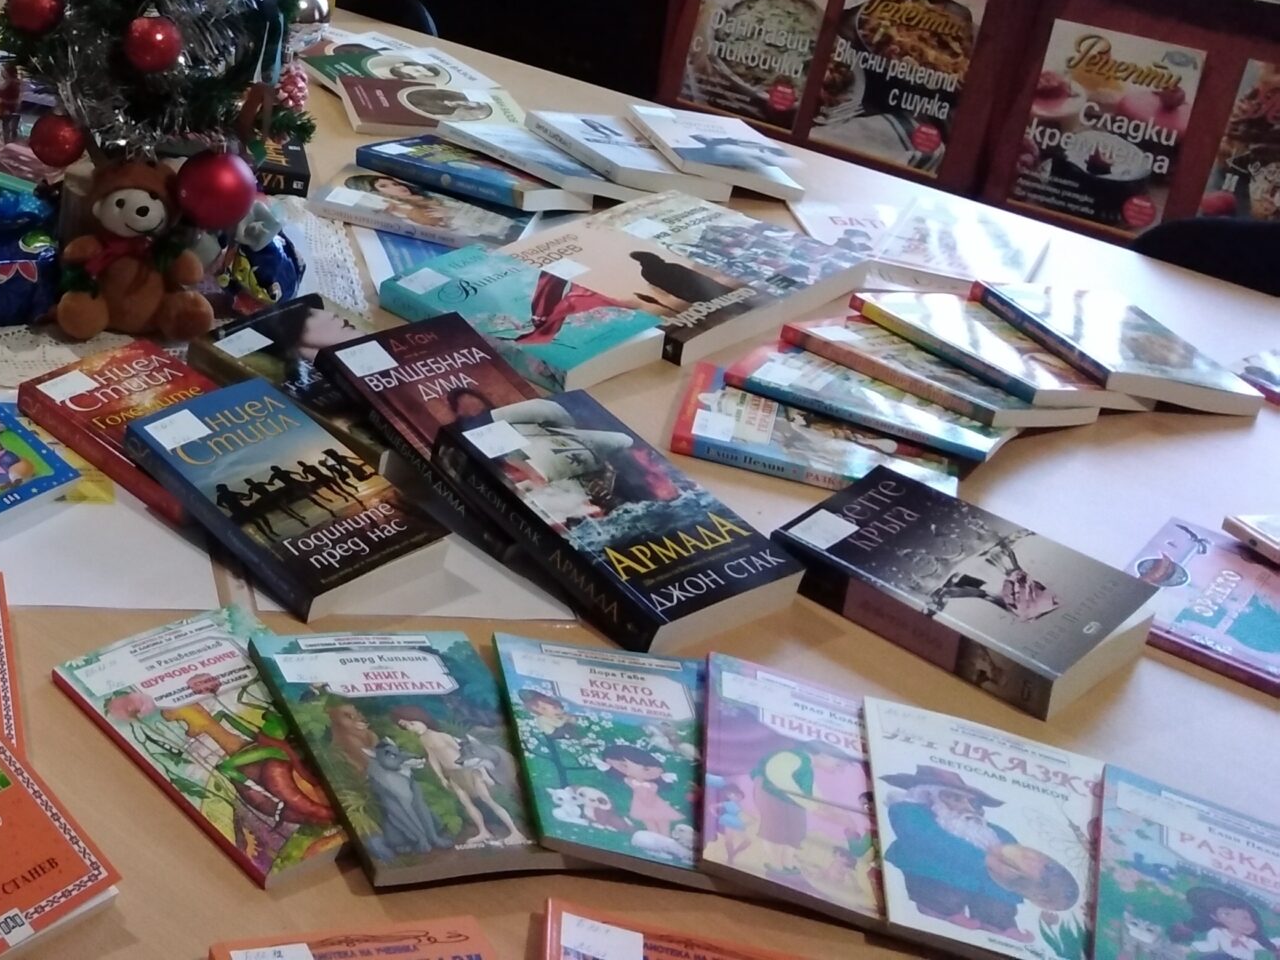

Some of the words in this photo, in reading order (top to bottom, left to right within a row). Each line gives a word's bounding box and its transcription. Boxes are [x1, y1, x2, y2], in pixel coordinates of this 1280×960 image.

[710, 7, 816, 54] Фантазии
[692, 35, 704, 52] с
[707, 39, 806, 80] тиквички
[833, 37, 886, 73] Вкусни
[887, 58, 958, 94] рецепти
[1066, 33, 1184, 93] Рецепти
[888, 88, 899, 107] с
[900, 90, 951, 121] шунка
[1078, 100, 1179, 147] Сладки
[93, 352, 171, 388] ниел
[363, 345, 492, 395] ВЪЛШЕБНАТА
[417, 370, 480, 404] ДУМА
[63, 368, 185, 416] Стийл
[206, 394, 287, 431] ниел
[172, 408, 303, 467] Стийл
[282, 500, 395, 557] Годините
[309, 529, 370, 570] пред
[369, 517, 410, 543] нас
[603, 510, 754, 583] АРМАДА
[649, 567, 726, 614] ДЖОН
[724, 548, 788, 581] СТАК
[200, 649, 240, 669] КОНЧЕ
[338, 655, 376, 667] диард
[361, 669, 411, 682] КНИГА
[340, 682, 363, 695] ЗА
[363, 680, 447, 694] ДЖУНГЛАТА
[579, 687, 615, 703] БЯХ
[615, 691, 671, 712] МАЛКА
[588, 678, 655, 697] КОГАТО
[793, 699, 825, 715] арло
[769, 713, 862, 750] ПИНОК
[928, 754, 1008, 783] СВЕТОСЛАВ
[1010, 777, 1071, 802] МИНКОВ
[1179, 830, 1280, 879] РАЗКА
[1210, 856, 1240, 876] ЗА
[0, 856, 61, 896] СТАНЕВ
